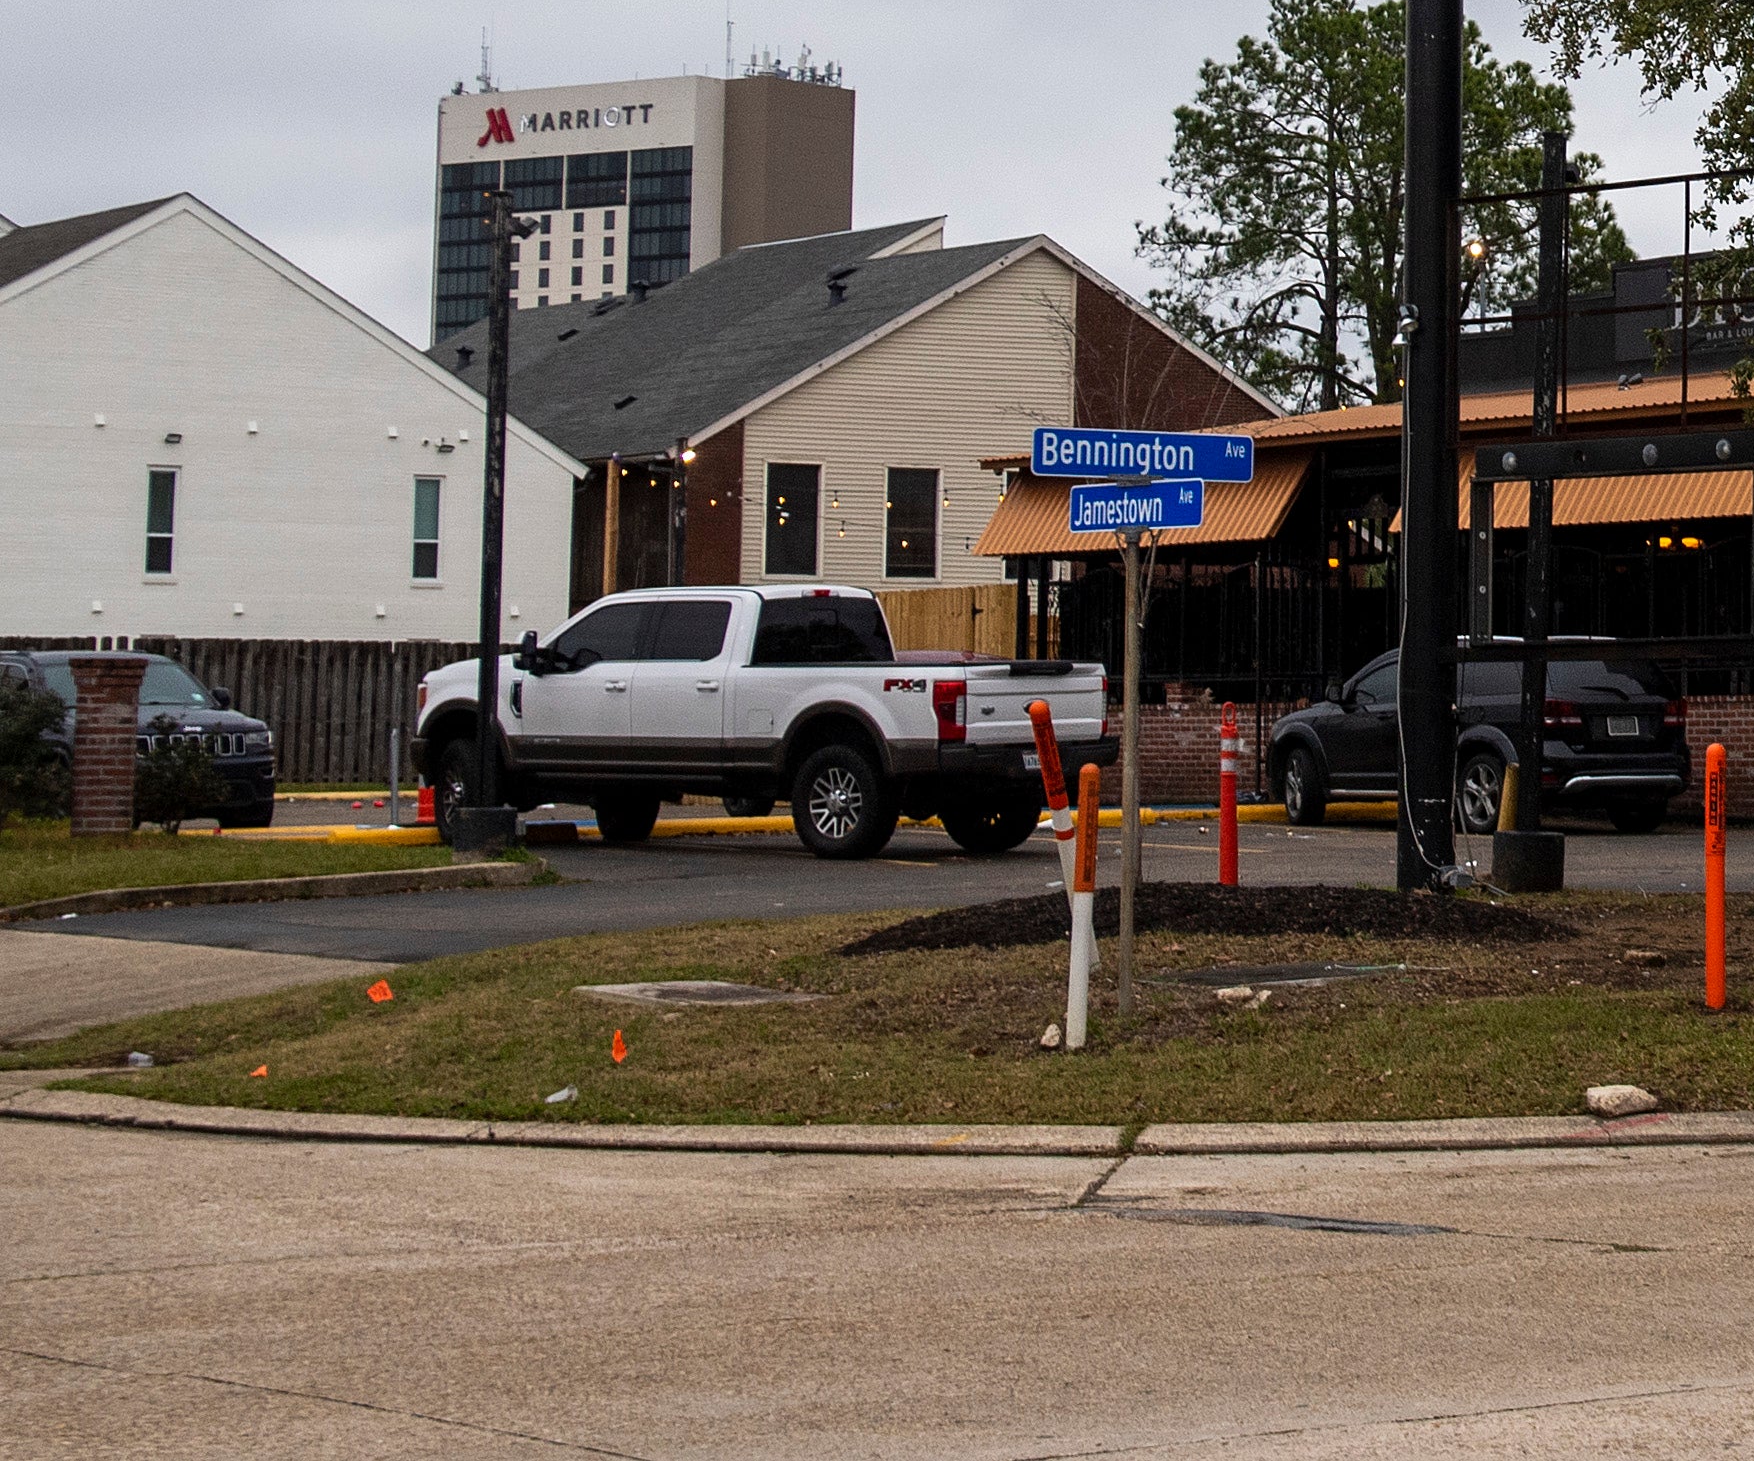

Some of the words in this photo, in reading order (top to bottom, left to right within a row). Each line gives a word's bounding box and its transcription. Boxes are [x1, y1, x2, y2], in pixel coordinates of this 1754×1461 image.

[519, 103, 654, 134] MARRIOTT
[1706, 330, 1725, 341] BAR
[1041, 431, 1195, 476] Bennington
[1225, 440, 1246, 459] Ave
[1074, 491, 1163, 527] Jamestown
[1178, 487, 1194, 505] Ave
[883, 678, 927, 693] FX4
